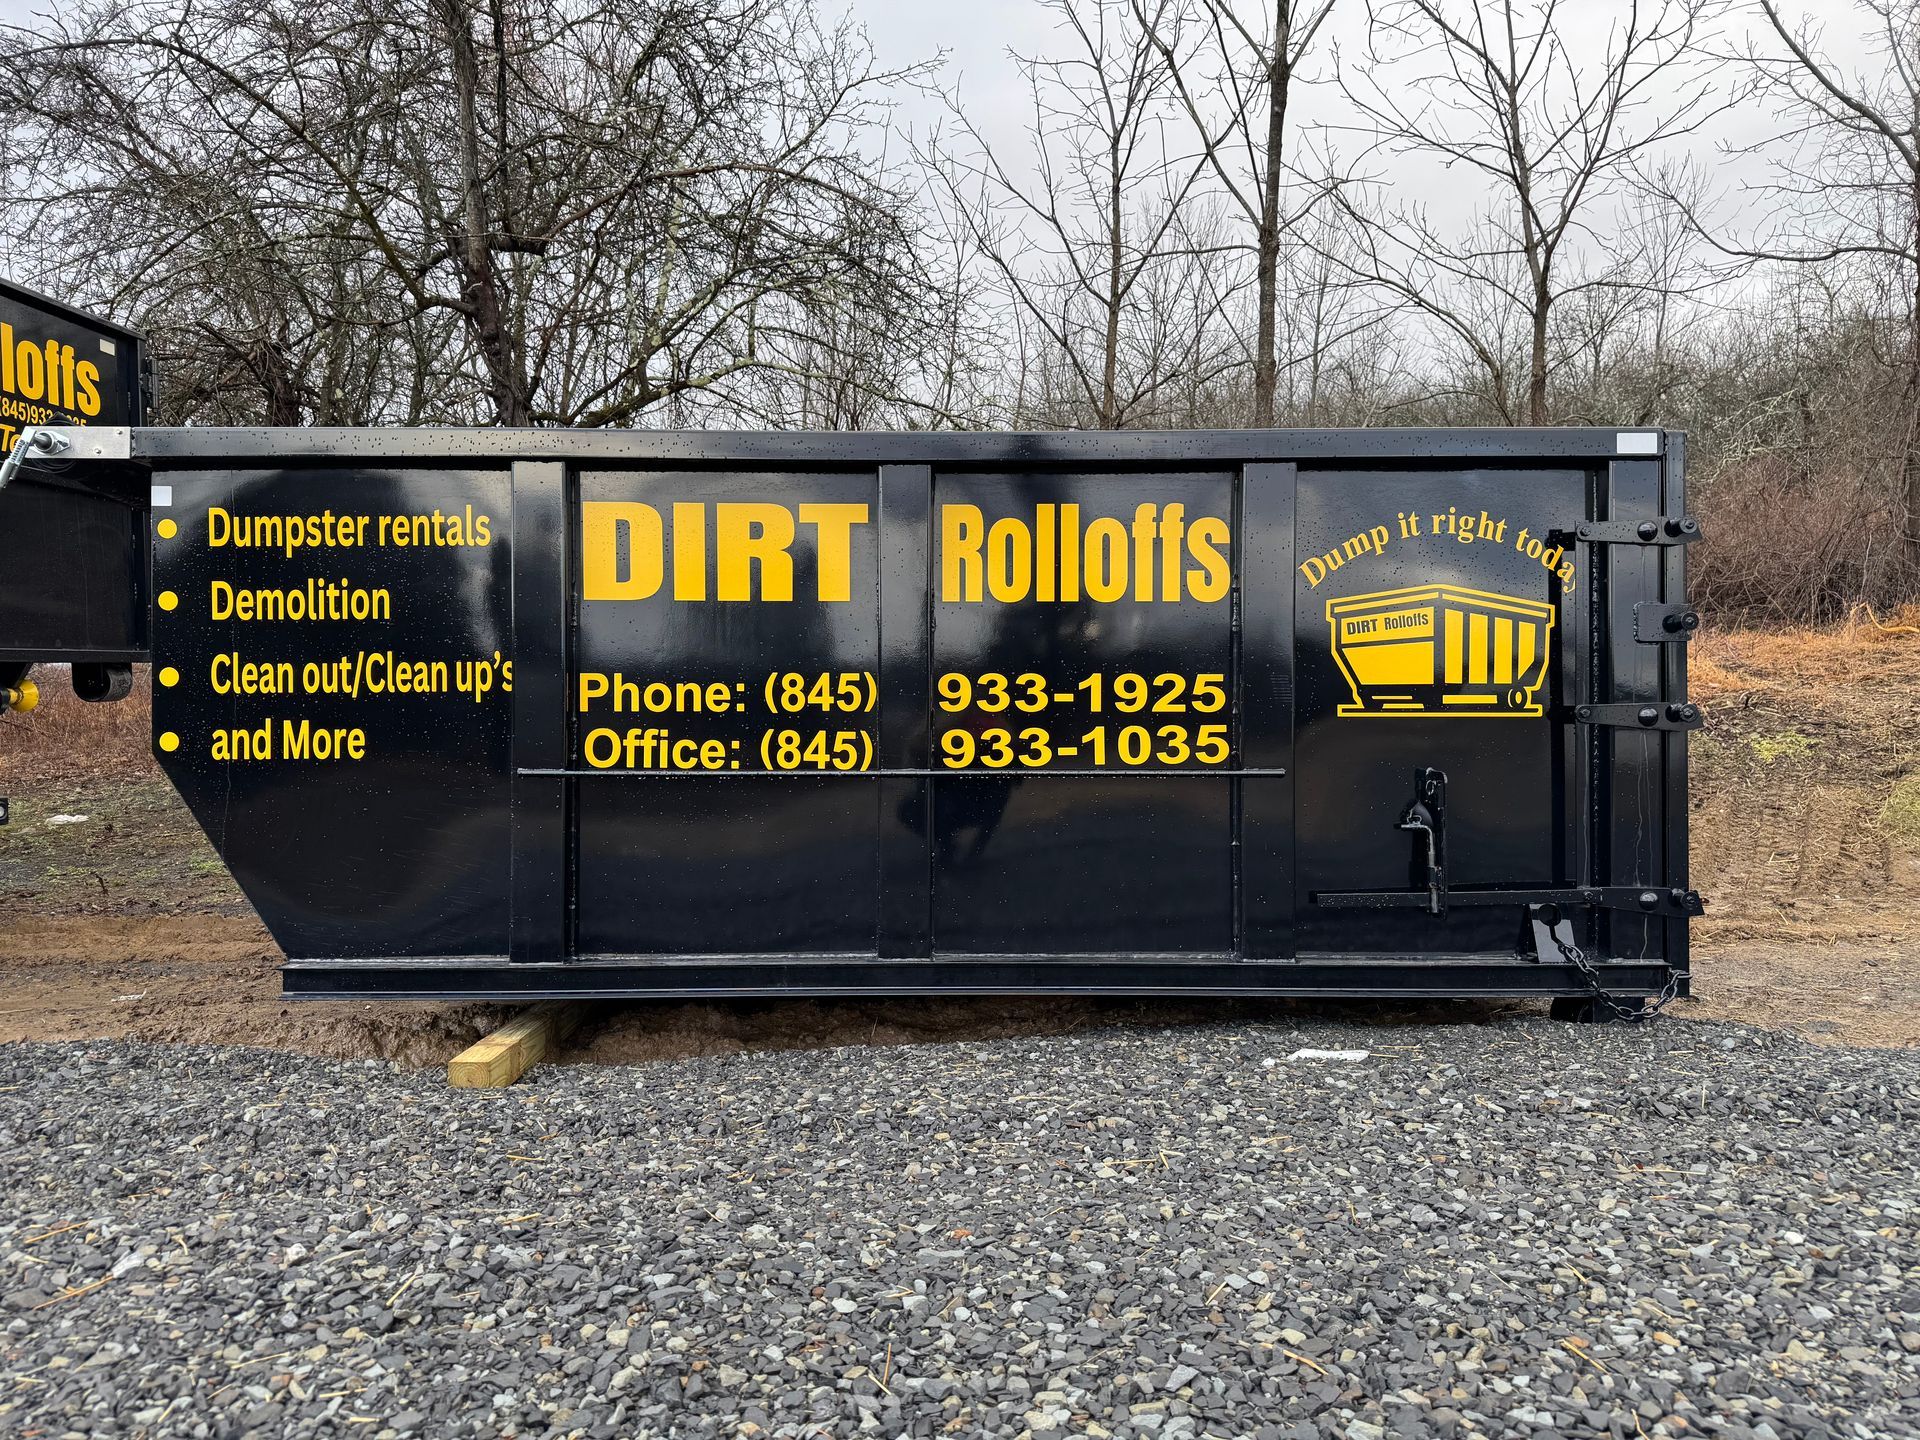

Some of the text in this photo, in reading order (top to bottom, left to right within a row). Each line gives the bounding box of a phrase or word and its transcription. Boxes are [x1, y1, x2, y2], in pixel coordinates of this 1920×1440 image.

[208, 504, 491, 558] Dumpster rentals
[582, 502, 1231, 604] DIRT Rolloffs
[1298, 523, 1390, 589] Dump
[1397, 511, 1421, 539] it
[1431, 506, 1508, 544] right
[211, 578, 391, 620] Demolition
[1346, 612, 1429, 635] DIRT Rolloffs
[210, 650, 513, 703] Clean out/Clean up's
[579, 673, 1227, 713] Phone: (845) 933-1925
[211, 718, 366, 760] and More
[584, 724, 1230, 773] Office: (845) 933-1035
